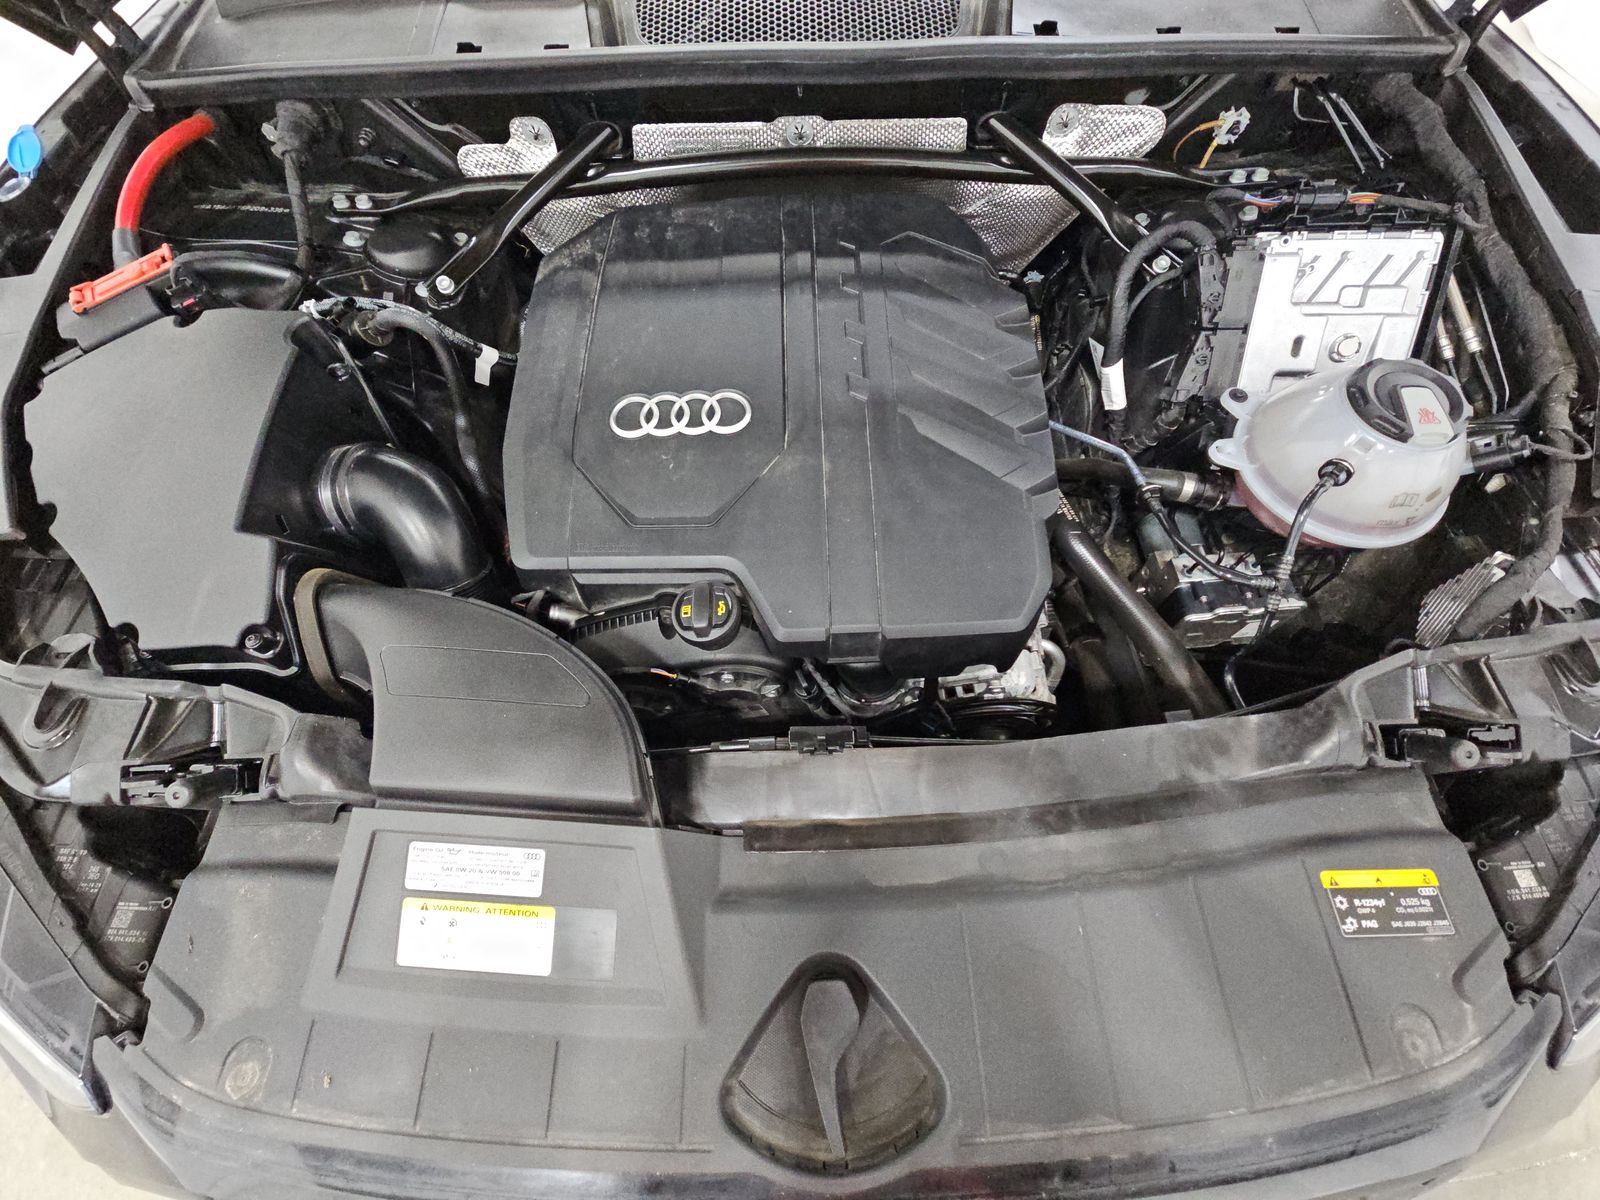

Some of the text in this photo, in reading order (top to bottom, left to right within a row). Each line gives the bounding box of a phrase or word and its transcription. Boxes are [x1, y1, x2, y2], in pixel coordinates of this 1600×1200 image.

[1419, 897, 1431, 907] kg
[432, 904, 539, 918] WARNING ATTENTION
[1361, 919, 1379, 929] PAG
